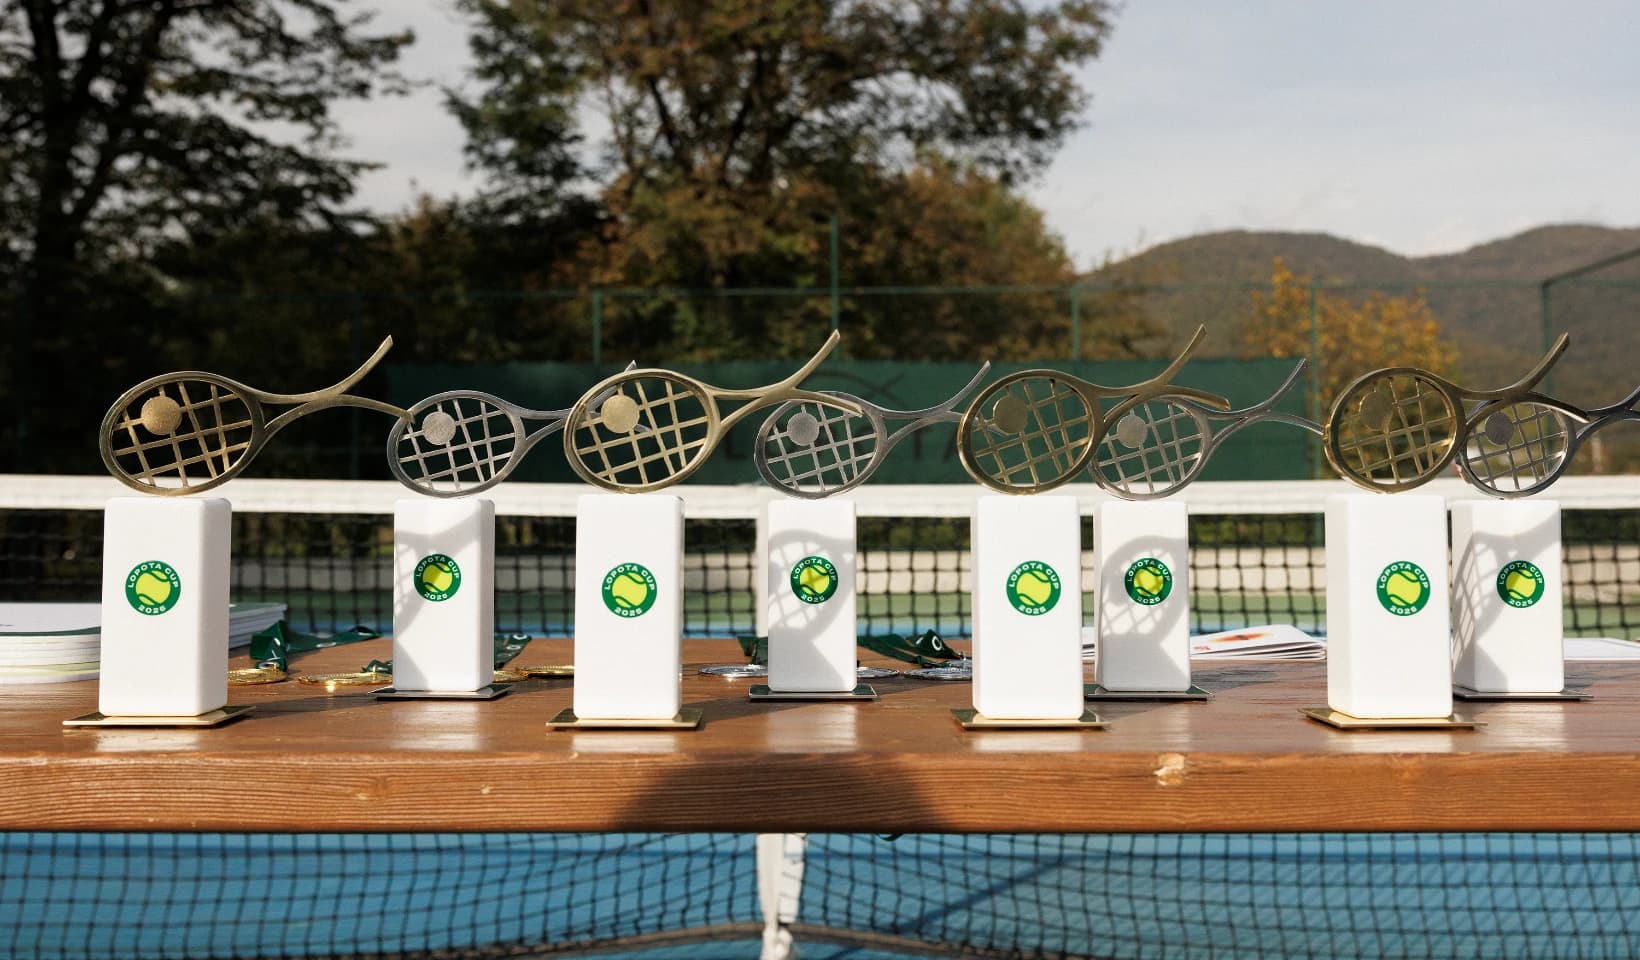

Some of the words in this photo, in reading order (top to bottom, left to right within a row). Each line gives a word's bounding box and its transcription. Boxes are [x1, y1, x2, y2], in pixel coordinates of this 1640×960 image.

[129, 563, 162, 588] LOPOTA
[165, 567, 178, 588] CUP
[416, 556, 445, 577] LOPOTA
[448, 560, 460, 579] CUP
[605, 564, 638, 590] LOPOTA
[641, 568, 654, 591] CUP
[793, 558, 822, 579] LOPOTA
[825, 562, 837, 581] CUP
[1010, 563, 1043, 588] LOPOTA
[1046, 567, 1059, 589] CUP
[1127, 560, 1156, 582] LOPOTA
[1158, 563, 1171, 582] CUP
[1380, 563, 1412, 588] LOPOTA
[1416, 568, 1429, 589] CUP
[1499, 563, 1528, 584] LOPOTA
[1530, 566, 1543, 584] CUP
